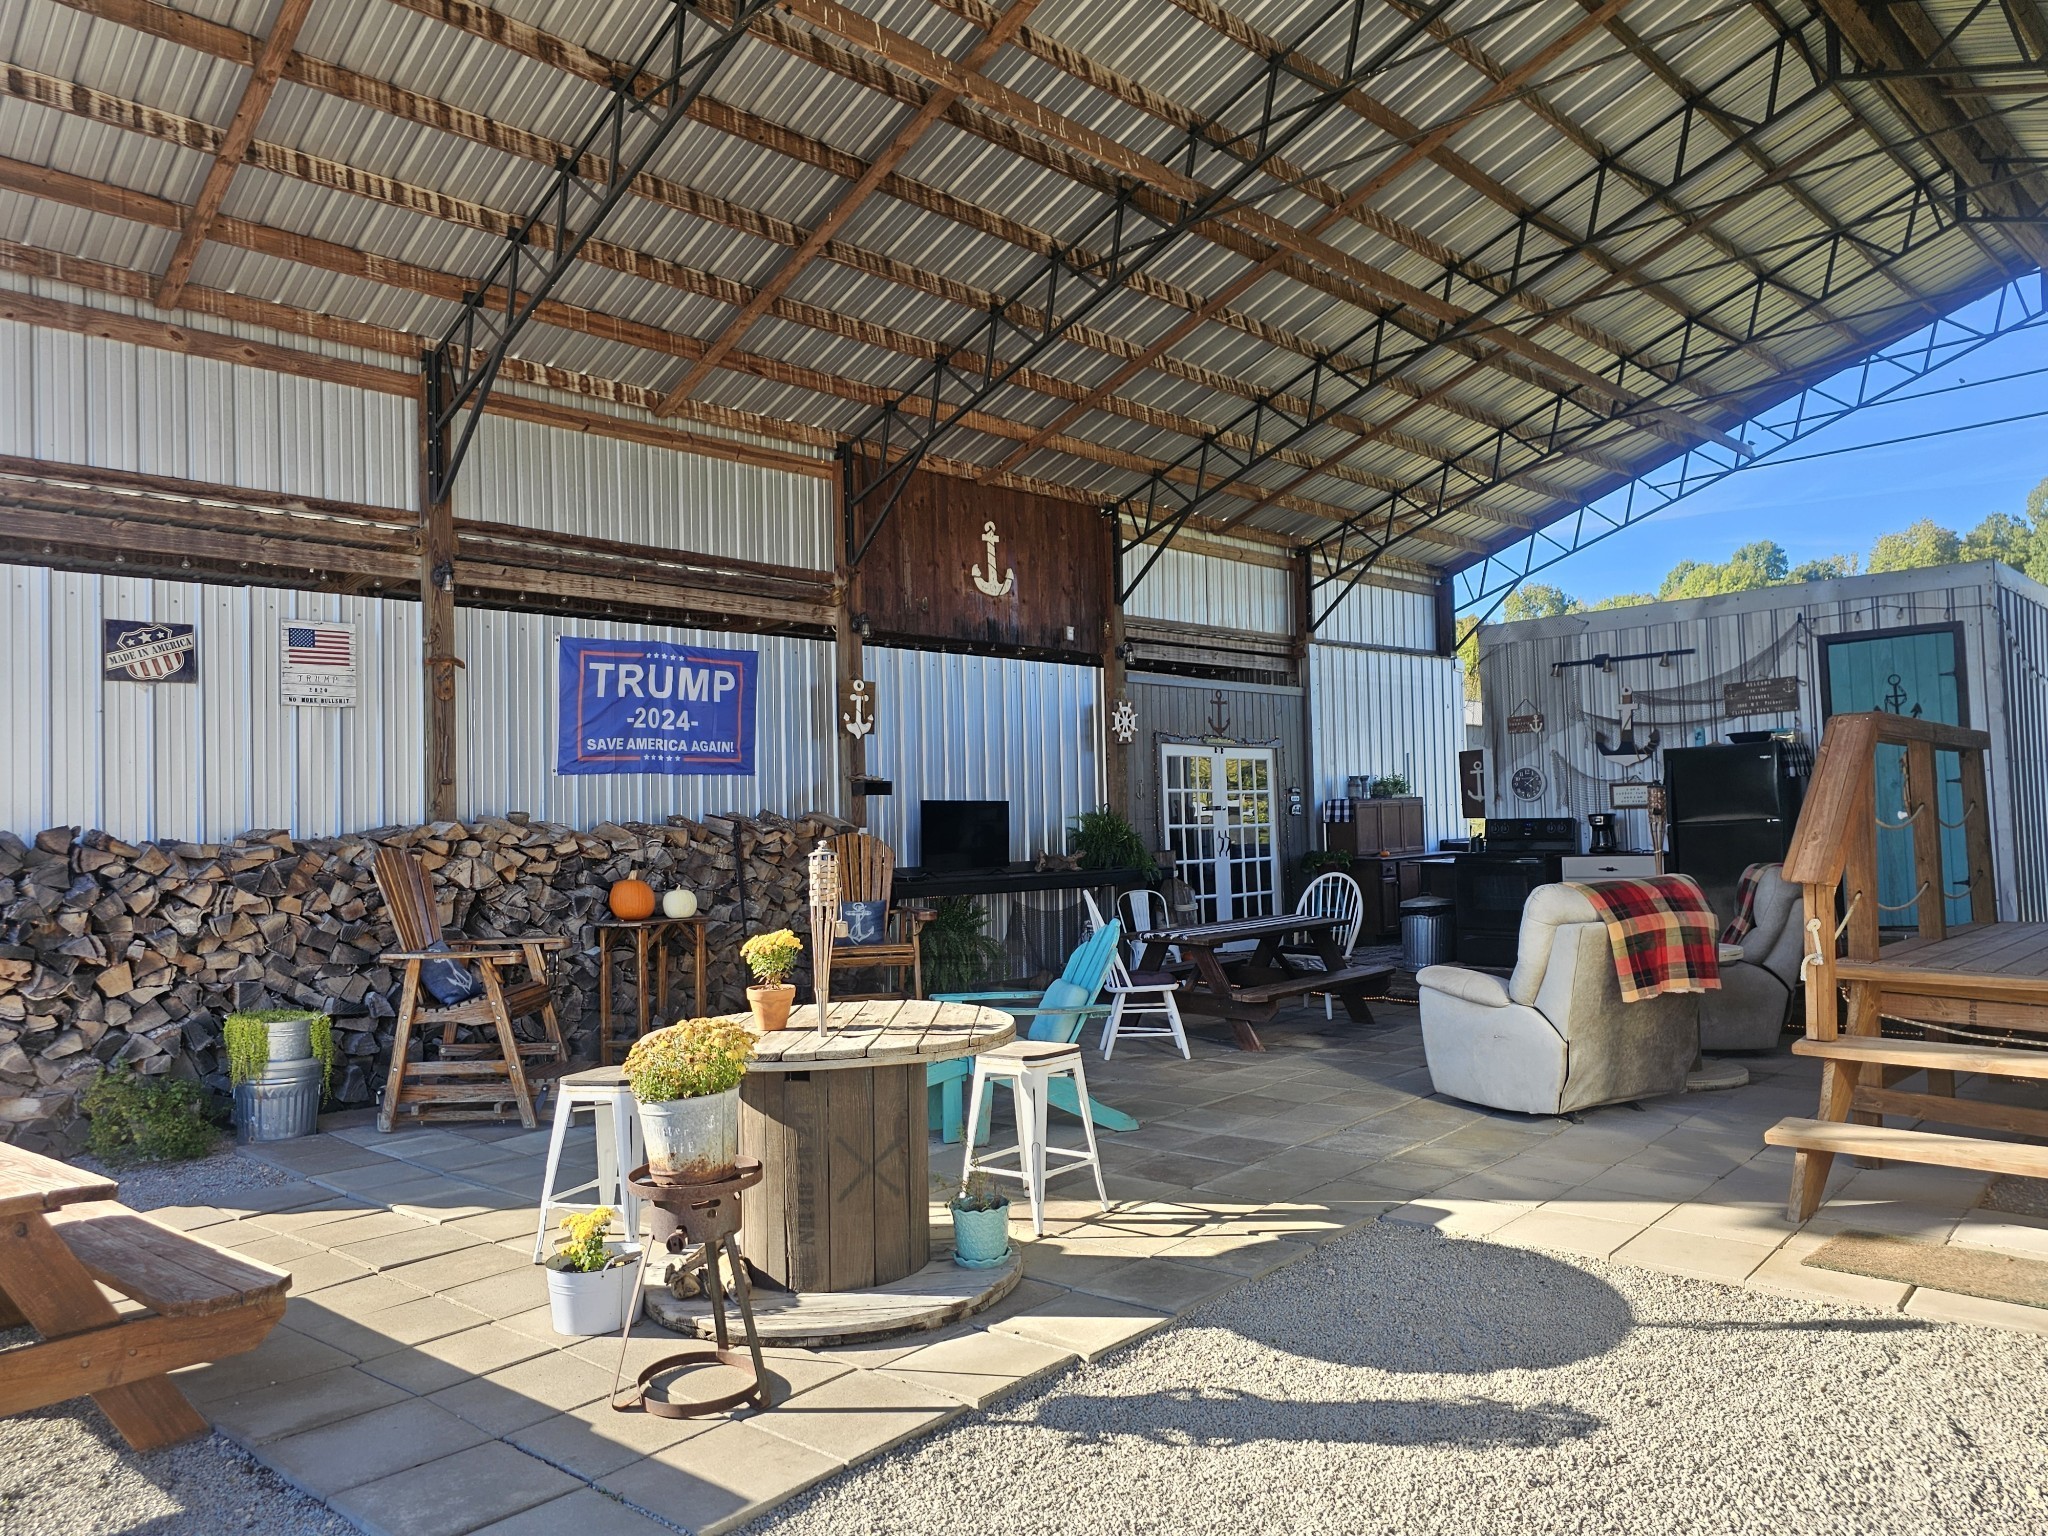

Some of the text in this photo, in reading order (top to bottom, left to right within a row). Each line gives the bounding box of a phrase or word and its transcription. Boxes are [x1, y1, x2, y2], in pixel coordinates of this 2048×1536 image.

[109, 637, 192, 665] MADE IN AMERICA
[297, 674, 338, 684] TRUMP
[589, 662, 736, 702] TRUMP
[587, 737, 735, 753] SAVE AMERICA AGAIN!
